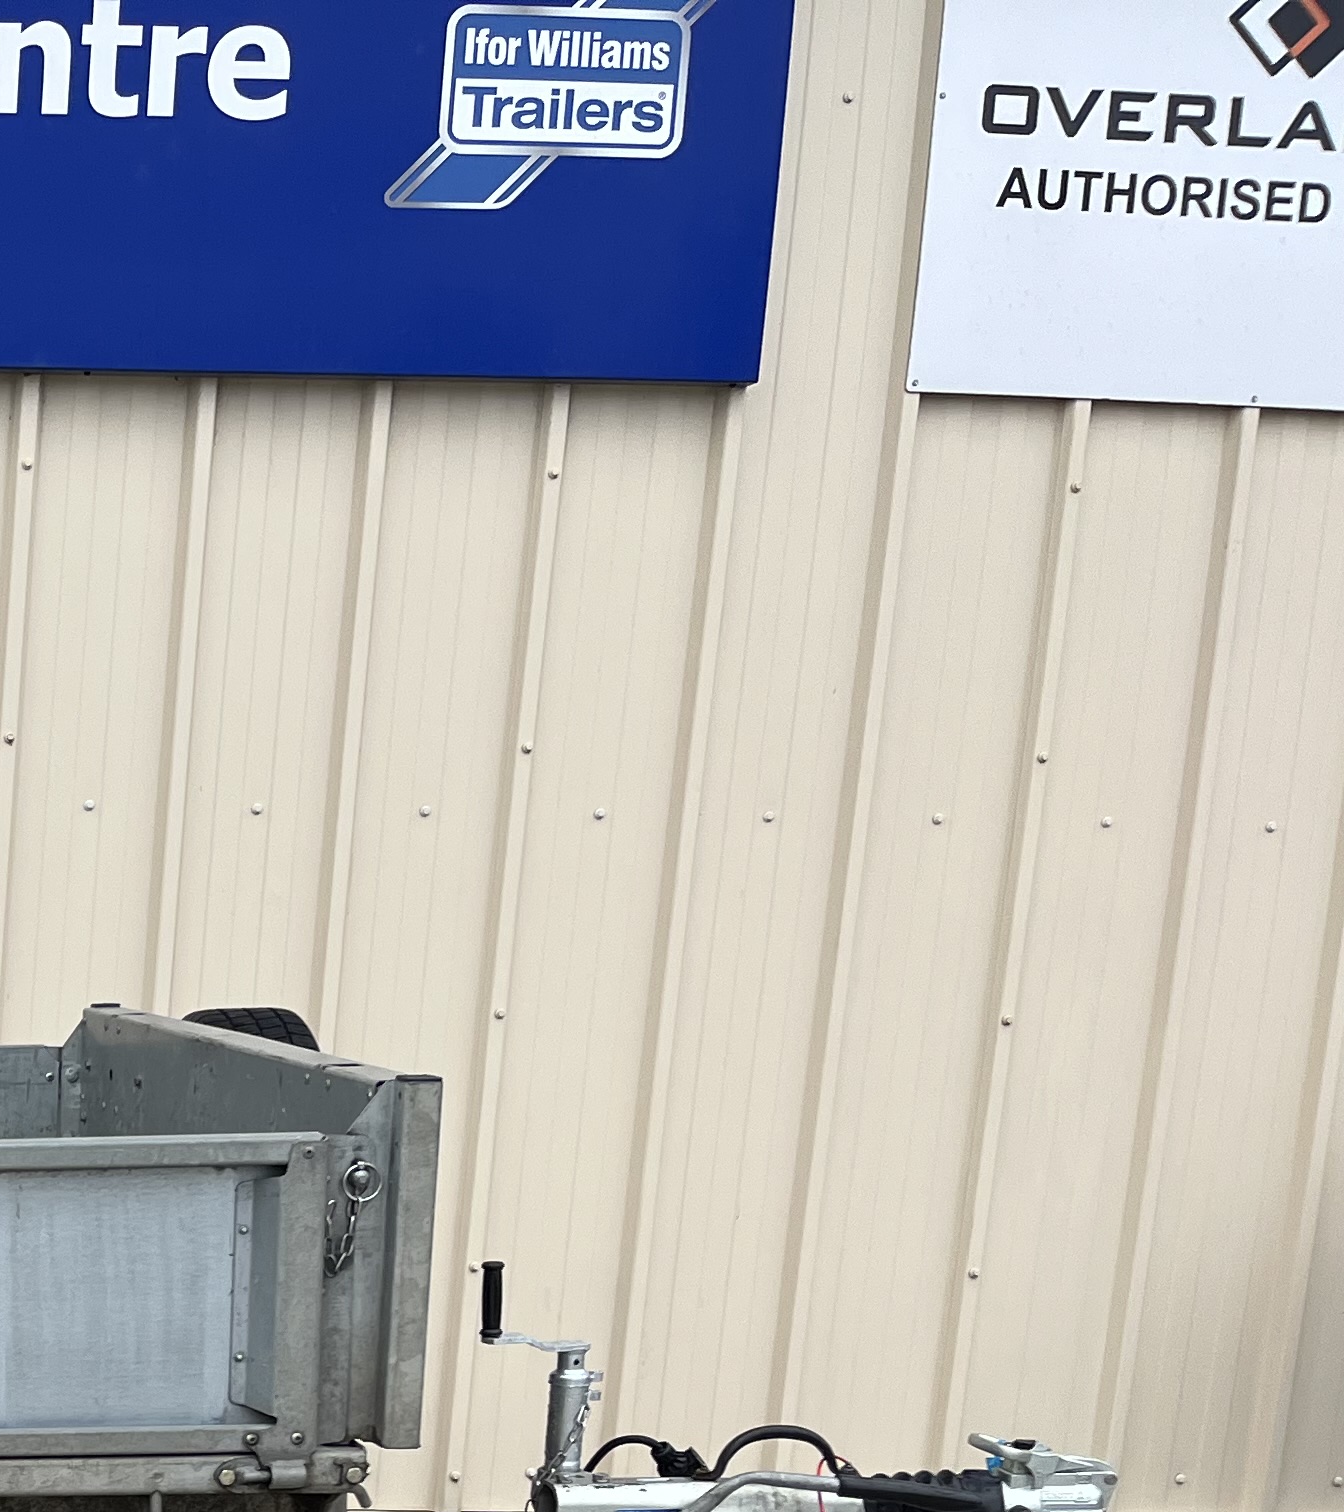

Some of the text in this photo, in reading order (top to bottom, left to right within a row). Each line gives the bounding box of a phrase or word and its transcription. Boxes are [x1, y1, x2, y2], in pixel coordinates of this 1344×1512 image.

[465, 27, 671, 71] Ifor Williams
[461, 85, 664, 133] Trailers
[982, 84, 1344, 151] OVERLA
[995, 167, 1332, 223] AUTHORISED
